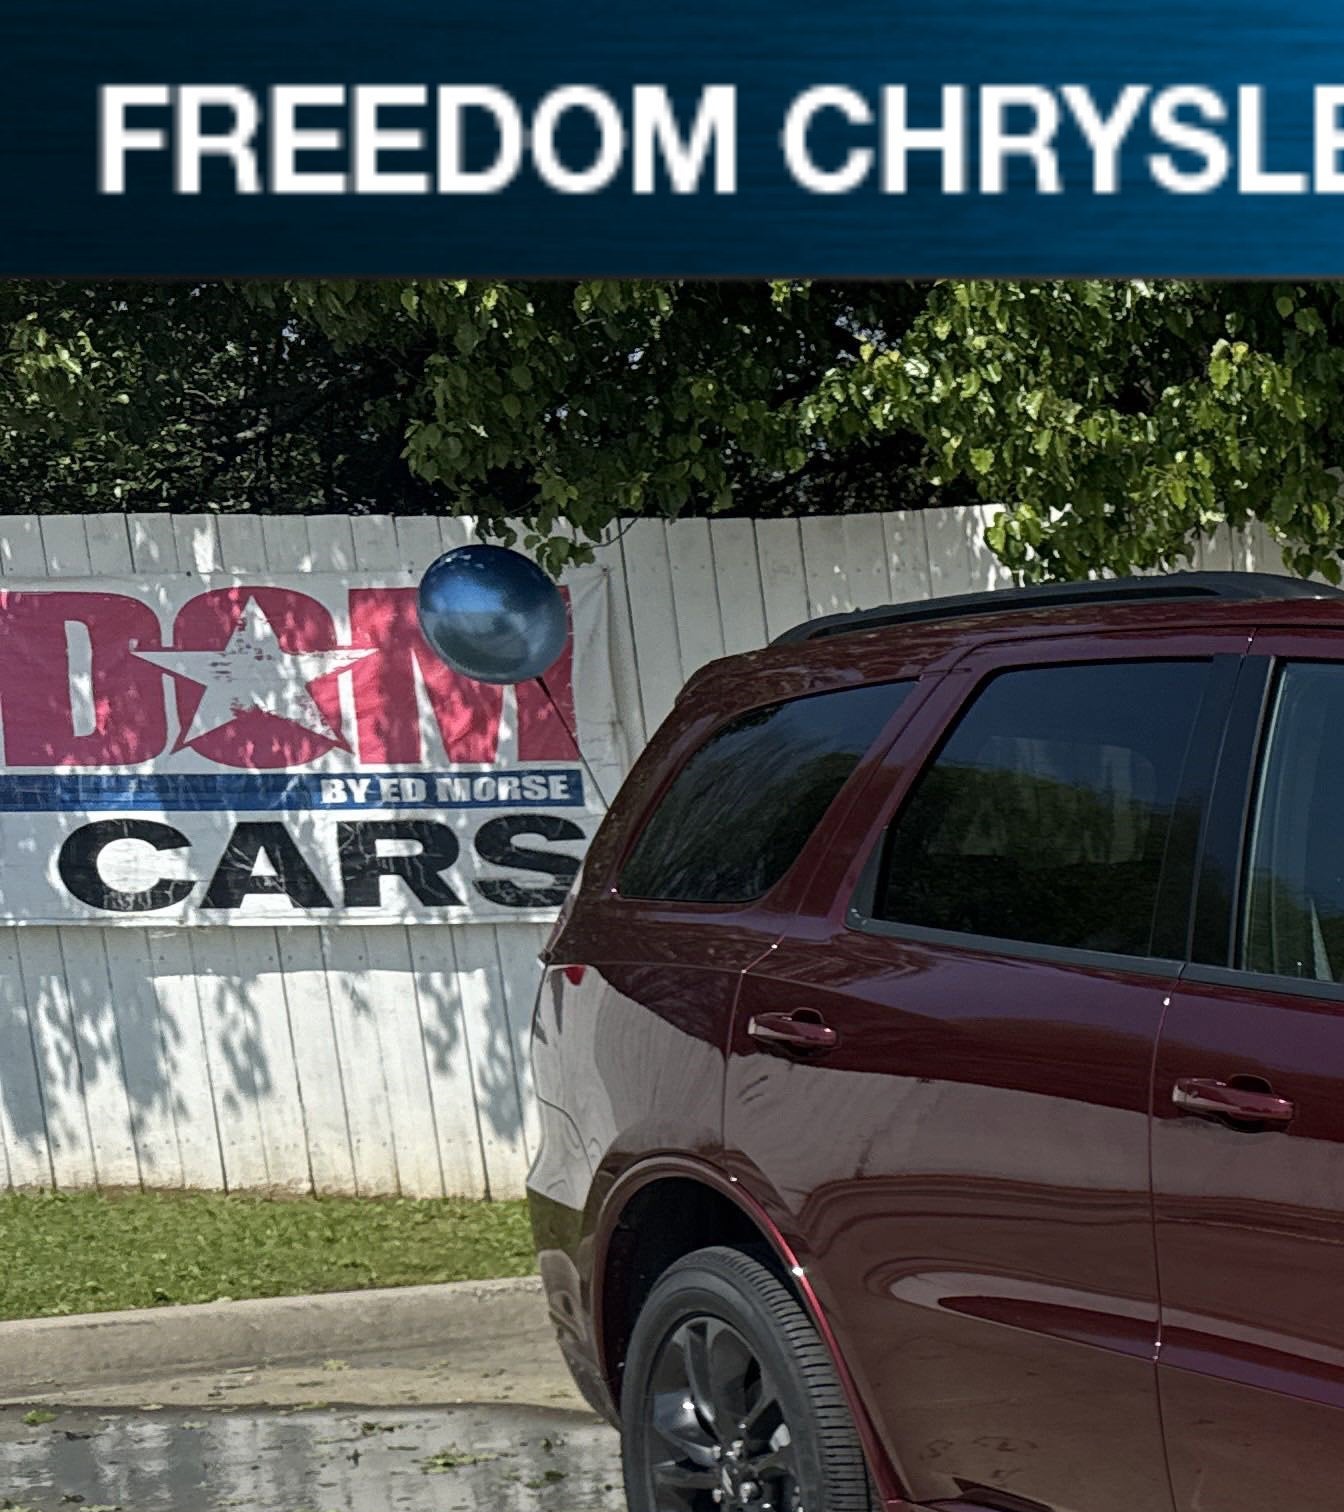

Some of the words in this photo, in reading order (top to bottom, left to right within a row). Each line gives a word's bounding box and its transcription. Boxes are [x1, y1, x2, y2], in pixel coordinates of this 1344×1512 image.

[320, 778, 371, 804] BY
[379, 778, 427, 803] ED
[436, 774, 571, 803] MORSE
[58, 813, 587, 911] CARS
